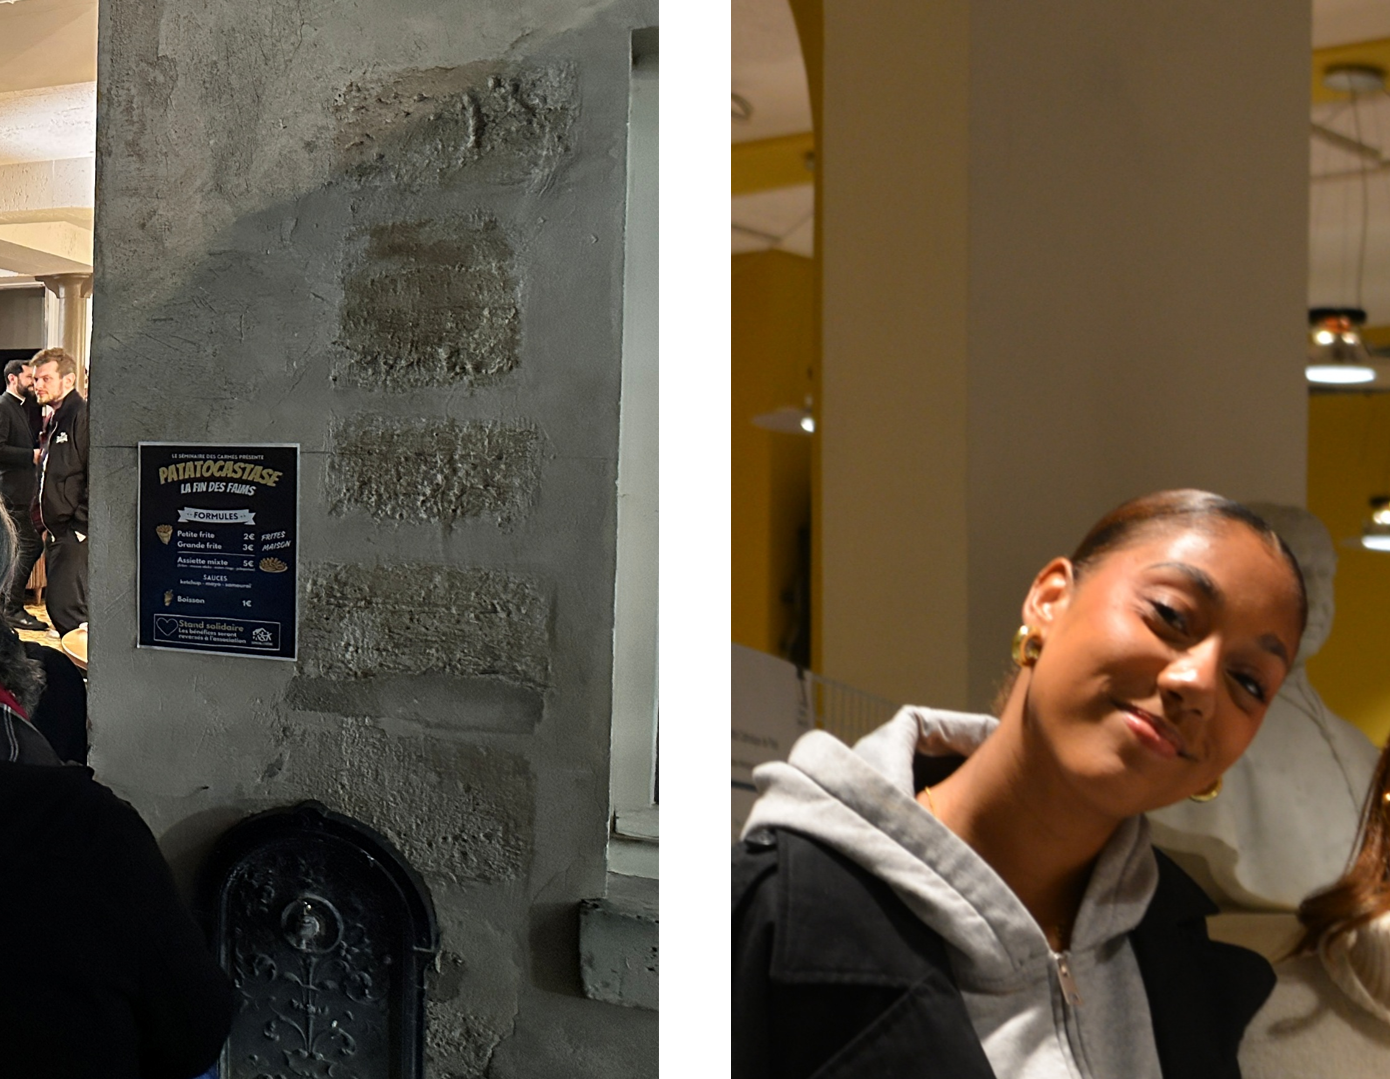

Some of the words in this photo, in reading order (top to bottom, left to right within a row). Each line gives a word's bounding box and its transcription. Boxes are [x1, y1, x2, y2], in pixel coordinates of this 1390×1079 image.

[158, 460, 283, 487] PATATOCASTASE
[180, 483, 191, 494] LA
[193, 482, 207, 492] FIN
[208, 481, 226, 493] DES
[227, 482, 257, 496] FAIMS
[194, 511, 239, 520] FORMULES
[177, 530, 198, 538] Petite
[199, 531, 215, 539] frite
[261, 531, 286, 541] FRITES
[177, 541, 205, 549] Grande
[206, 541, 222, 550] frite
[261, 540, 291, 551] MAISON
[177, 557, 206, 565] Assiette
[177, 595, 205, 604] Boisson
[179, 620, 204, 629] Stand
[206, 622, 244, 632] solidaire
[189, 628, 216, 636] bénéfices
